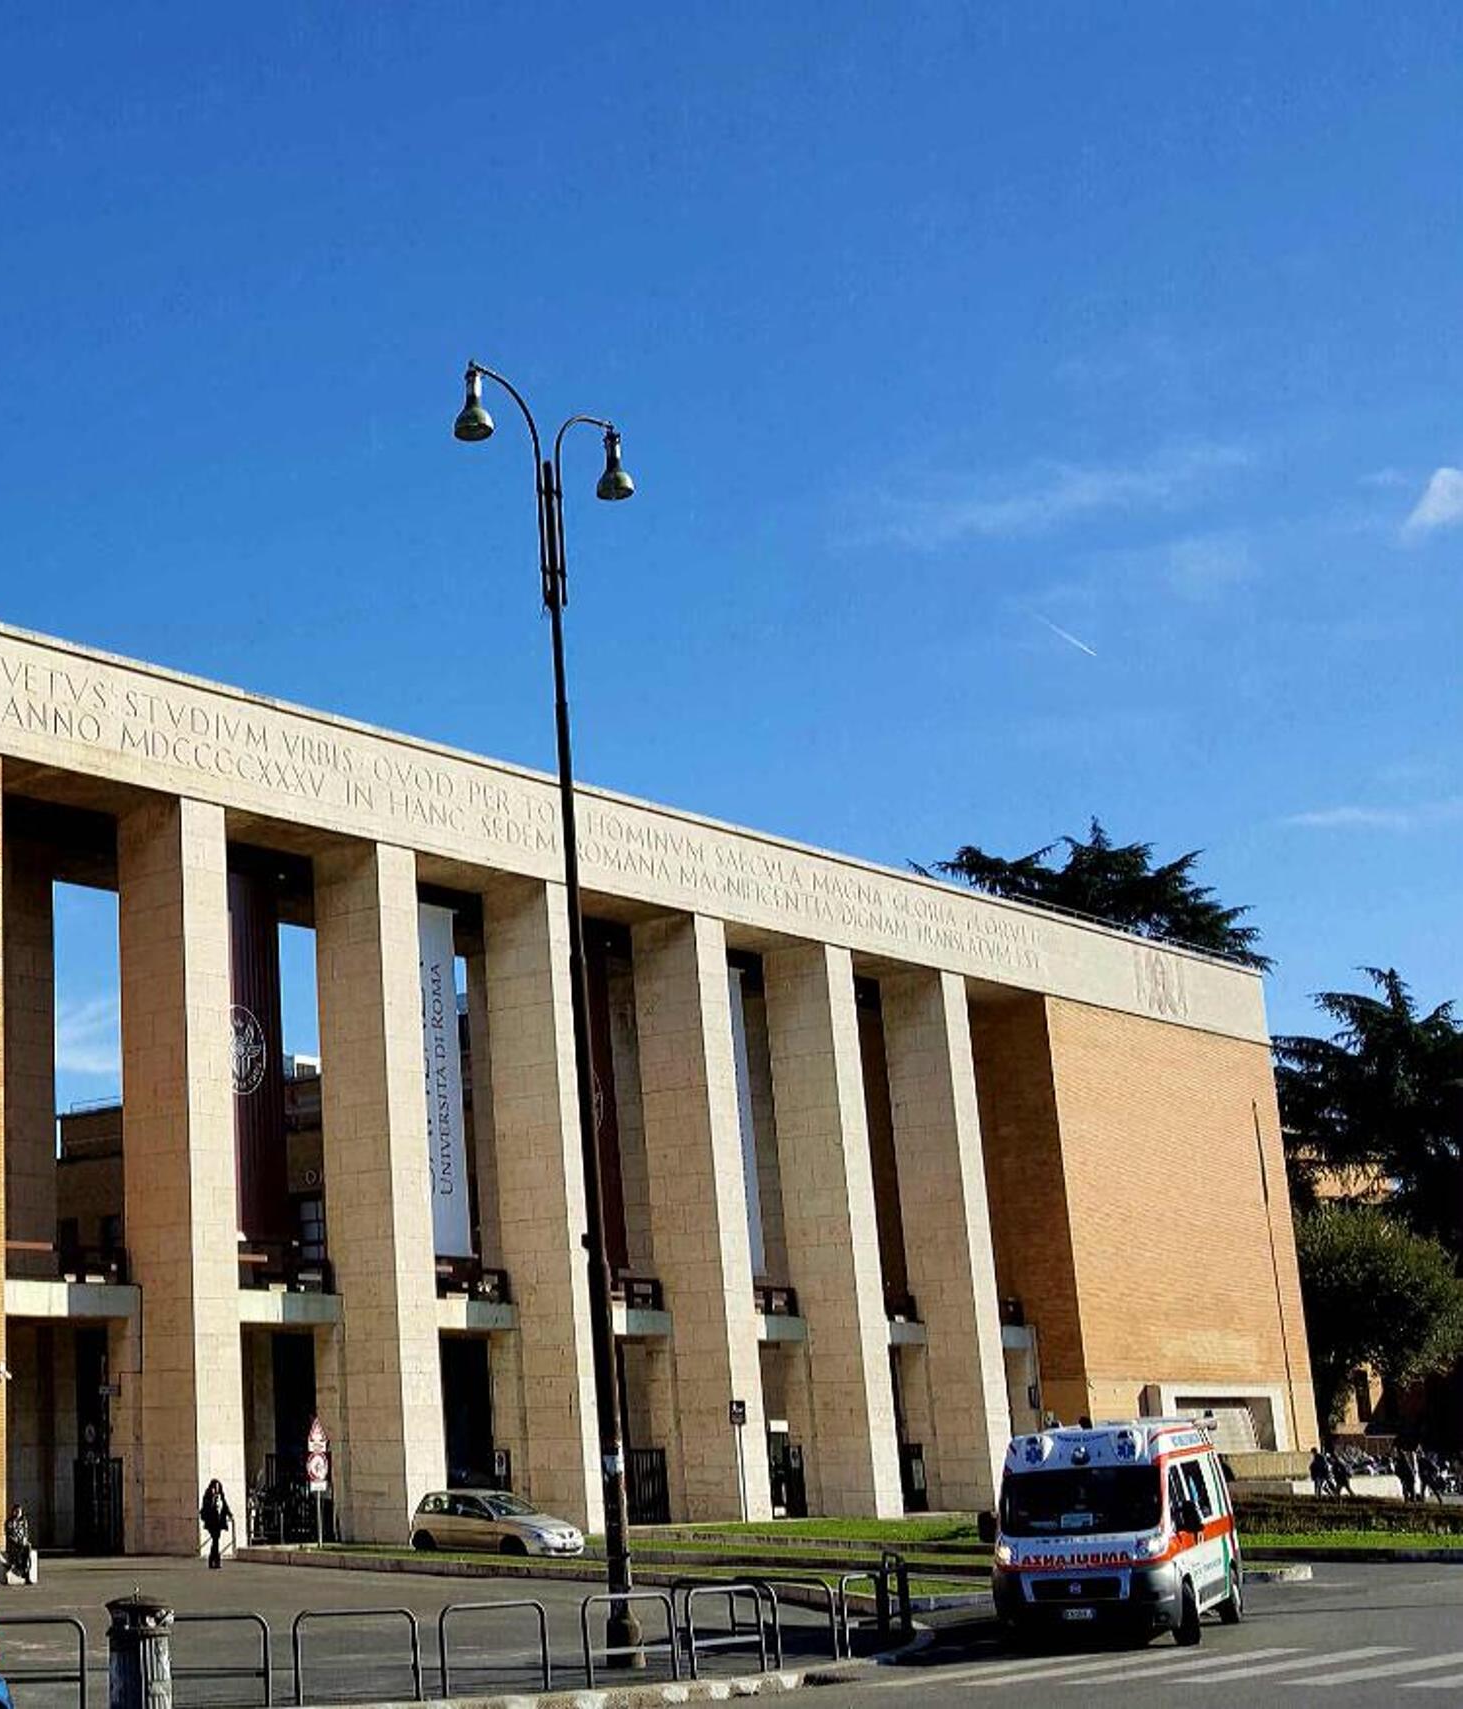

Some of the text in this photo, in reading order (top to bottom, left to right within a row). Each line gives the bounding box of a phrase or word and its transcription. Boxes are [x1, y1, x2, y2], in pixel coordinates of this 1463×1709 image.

[0, 656, 106, 708] VETVS
[126, 690, 268, 751] STVDIVM
[282, 731, 352, 772] VRBIS
[468, 779, 508, 816] PER
[526, 800, 556, 824] TO
[587, 811, 704, 862] HOMINVM
[812, 873, 883, 907] MAGNA
[2, 696, 101, 742] ANNO
[346, 779, 374, 810] IN
[389, 792, 464, 831] HANC
[481, 815, 558, 855] SEDEM
[842, 907, 909, 940] DIGNAM
[430, 963, 443, 1029] ROMA
[434, 1037, 446, 1059] DI
